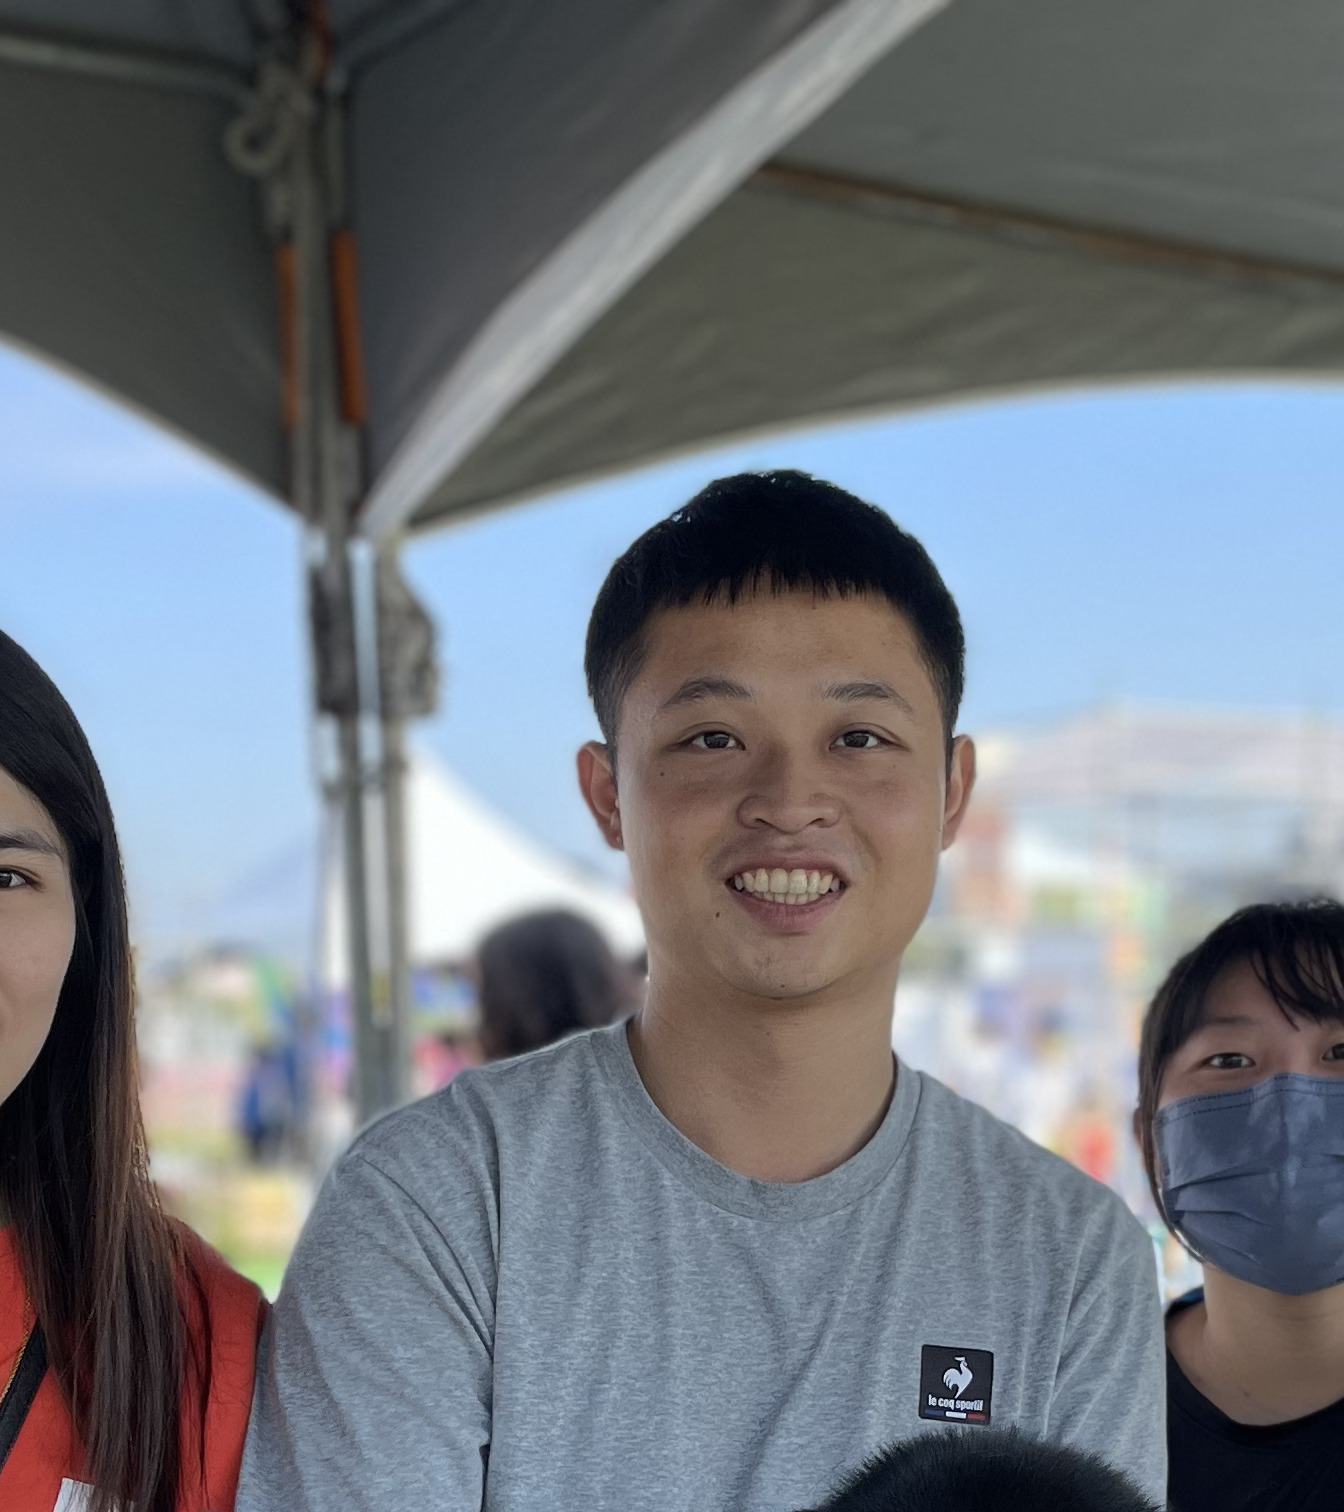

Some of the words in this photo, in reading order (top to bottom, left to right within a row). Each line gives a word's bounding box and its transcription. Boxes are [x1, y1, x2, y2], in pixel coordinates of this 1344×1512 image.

[928, 1394, 937, 1406] le
[938, 1398, 955, 1411] coq
[956, 1399, 984, 1412] sportif
